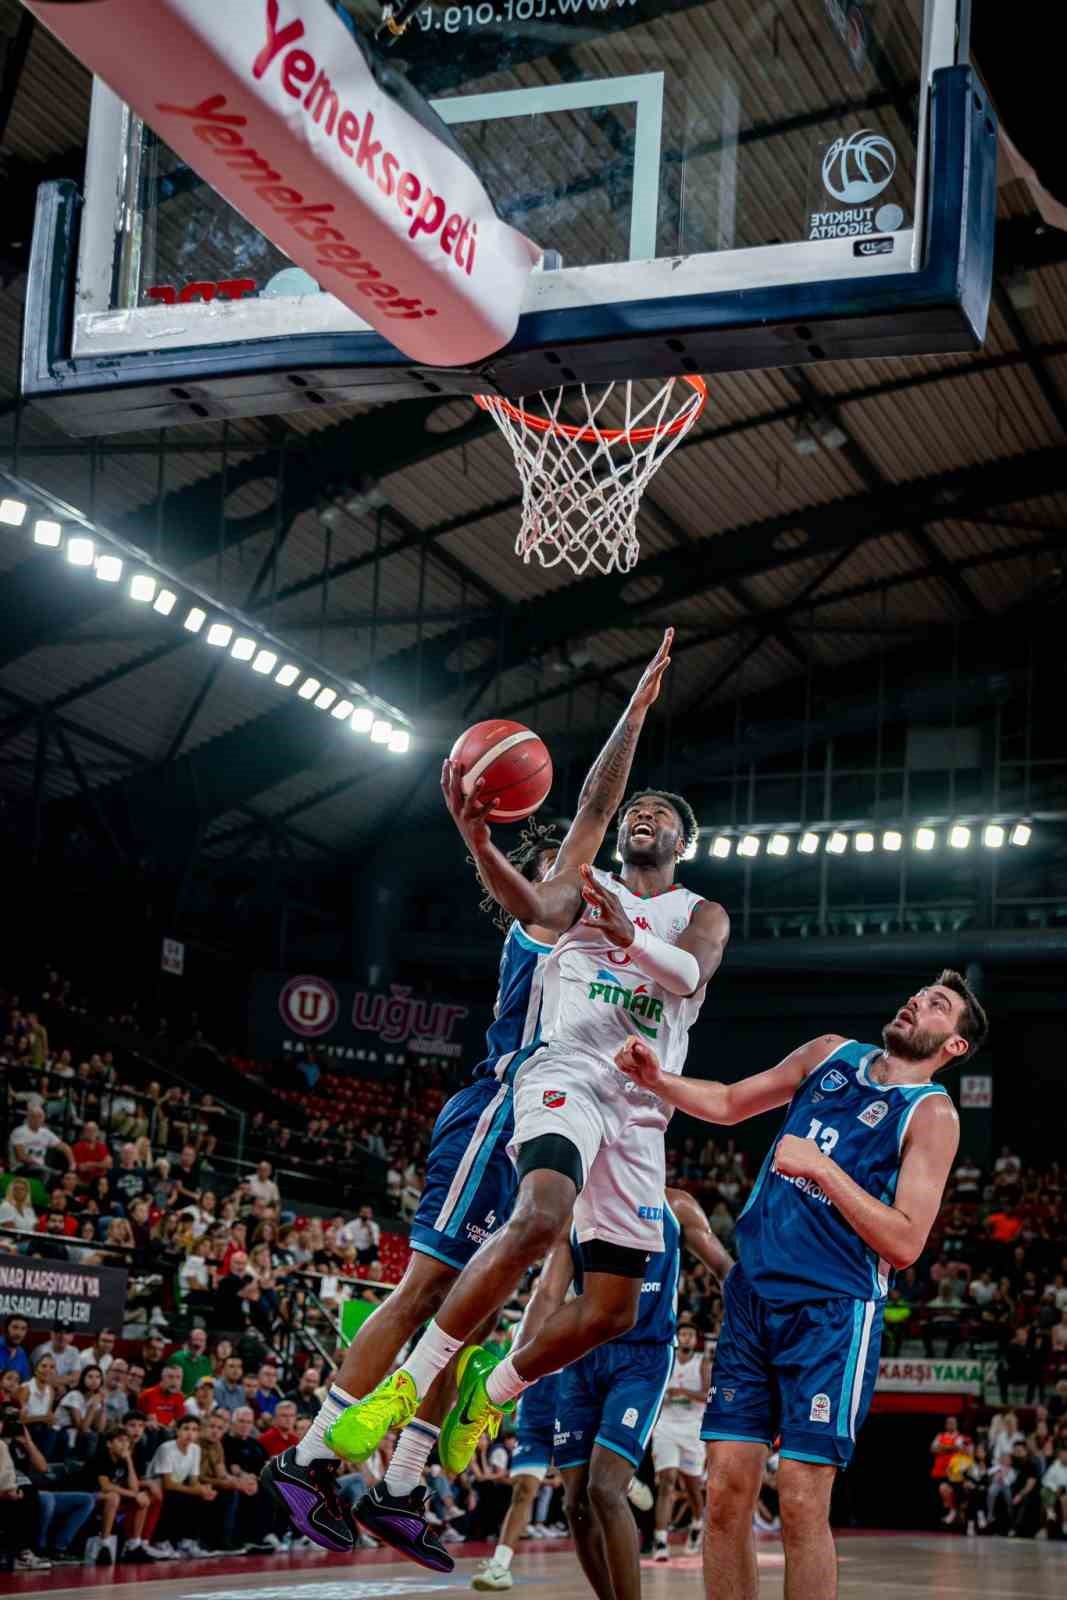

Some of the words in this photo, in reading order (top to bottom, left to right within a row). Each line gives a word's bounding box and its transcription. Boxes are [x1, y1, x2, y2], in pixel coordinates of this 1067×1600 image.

[155, 94, 437, 319] Yemeksepeti
[253, 0, 477, 275] Yemeksepeti
[352, 984, 469, 1043] uğur
[880, 1363, 981, 1385] KARŞIYAKA
